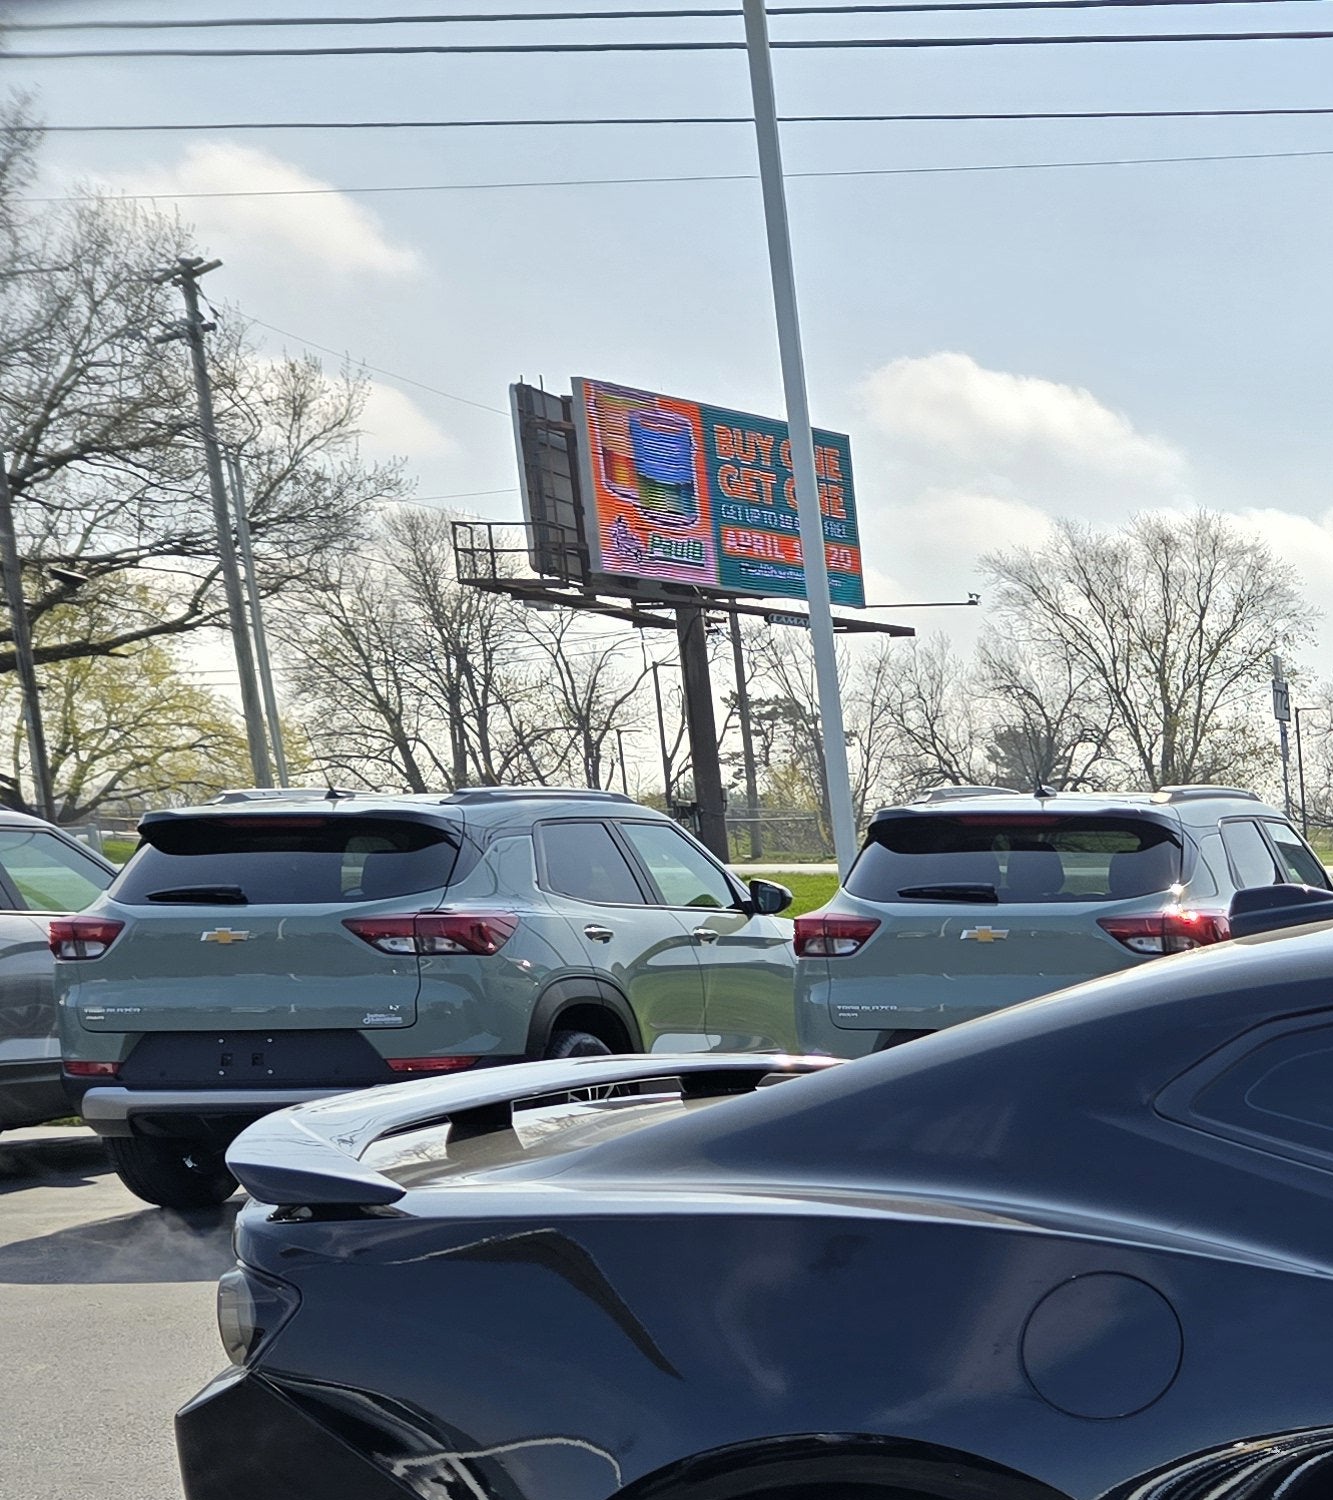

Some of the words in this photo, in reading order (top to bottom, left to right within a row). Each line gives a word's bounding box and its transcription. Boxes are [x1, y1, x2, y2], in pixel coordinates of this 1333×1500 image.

[713, 424, 774, 467] BUY
[718, 463, 777, 506] GET
[745, 507, 761, 524] UP
[761, 510, 778, 527] TO
[725, 529, 785, 560] APRIL
